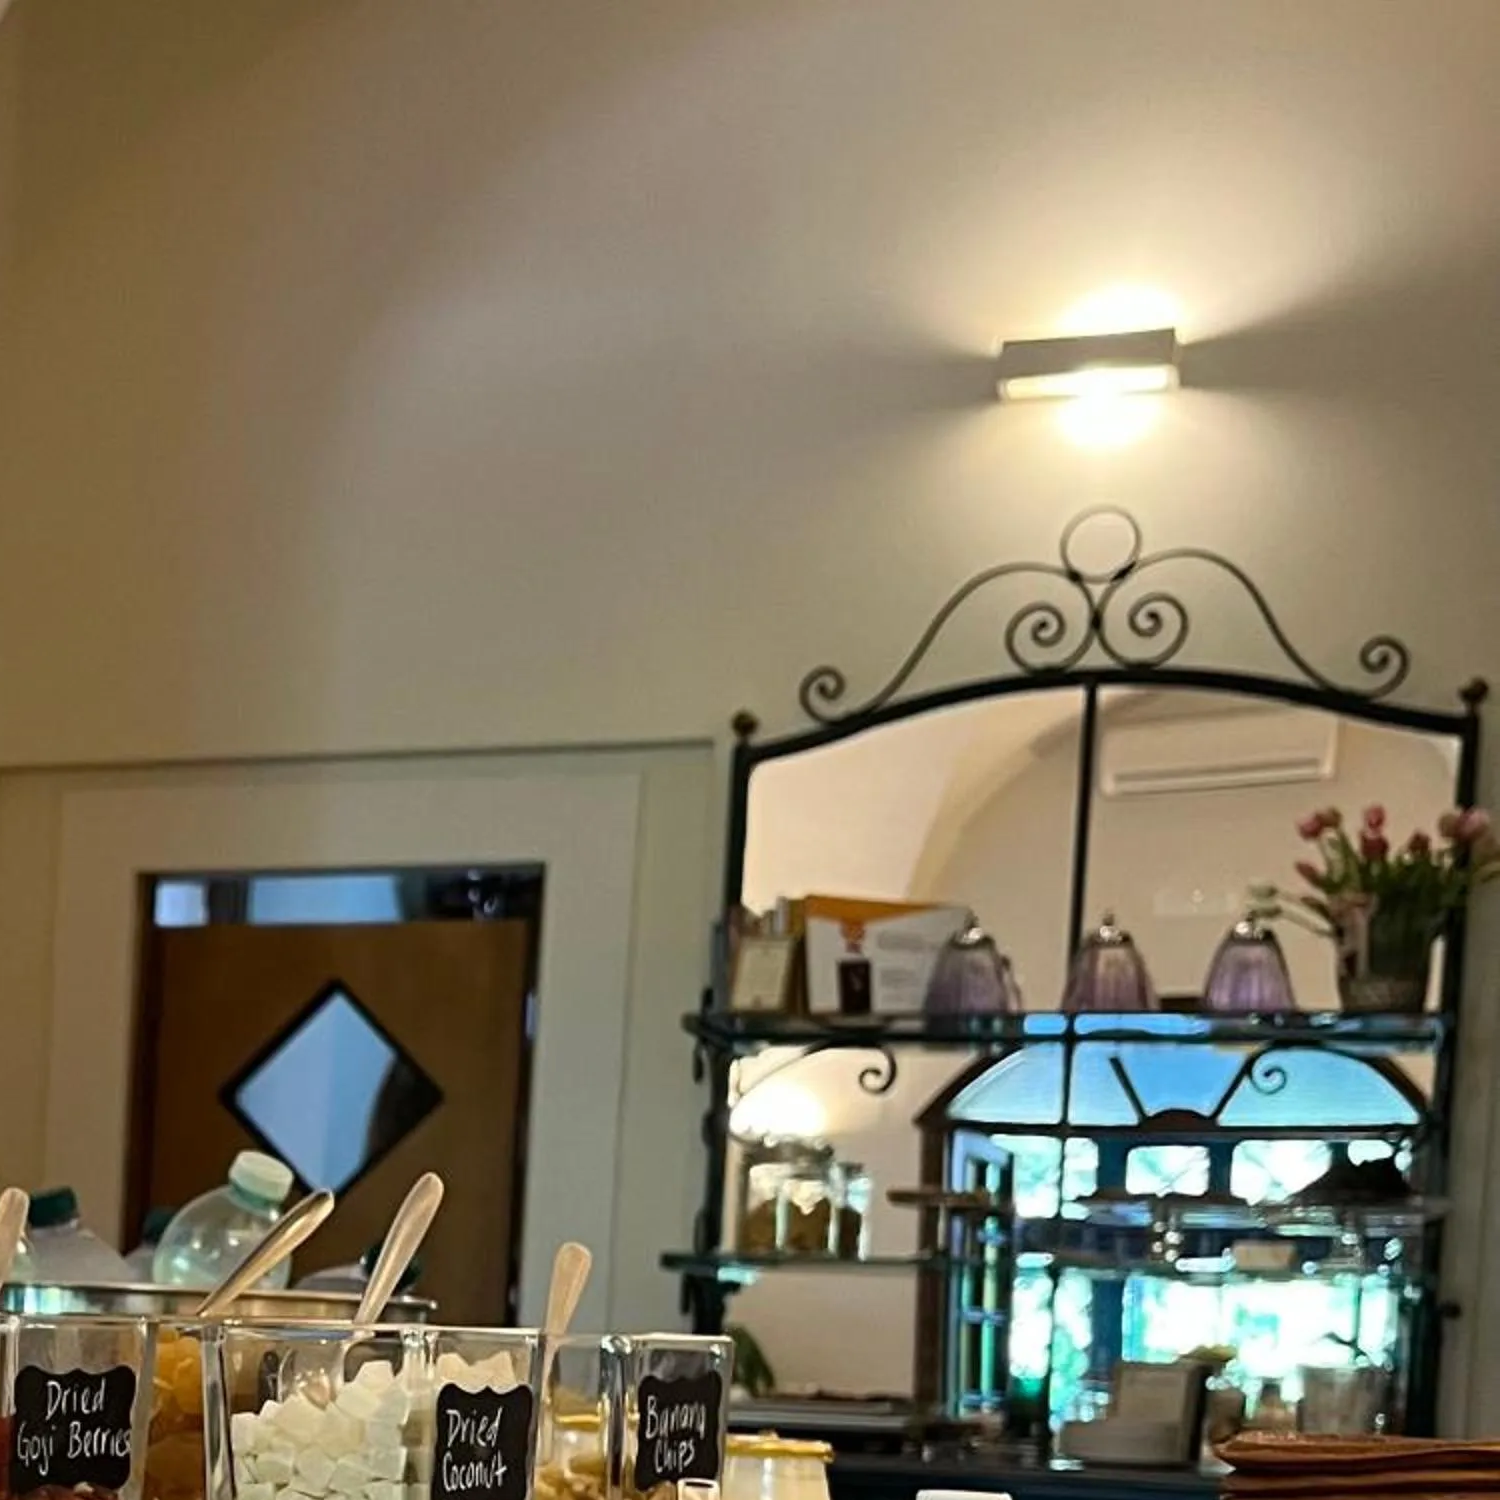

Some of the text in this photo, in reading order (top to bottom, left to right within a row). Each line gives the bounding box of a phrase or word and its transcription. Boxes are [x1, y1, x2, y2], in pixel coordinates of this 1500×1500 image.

[45, 1377, 106, 1421] Dried
[446, 1406, 504, 1448] Dried
[16, 1421, 57, 1477] Goji
[654, 1437, 695, 1474] Chips
[442, 1450, 508, 1493] Coconut
